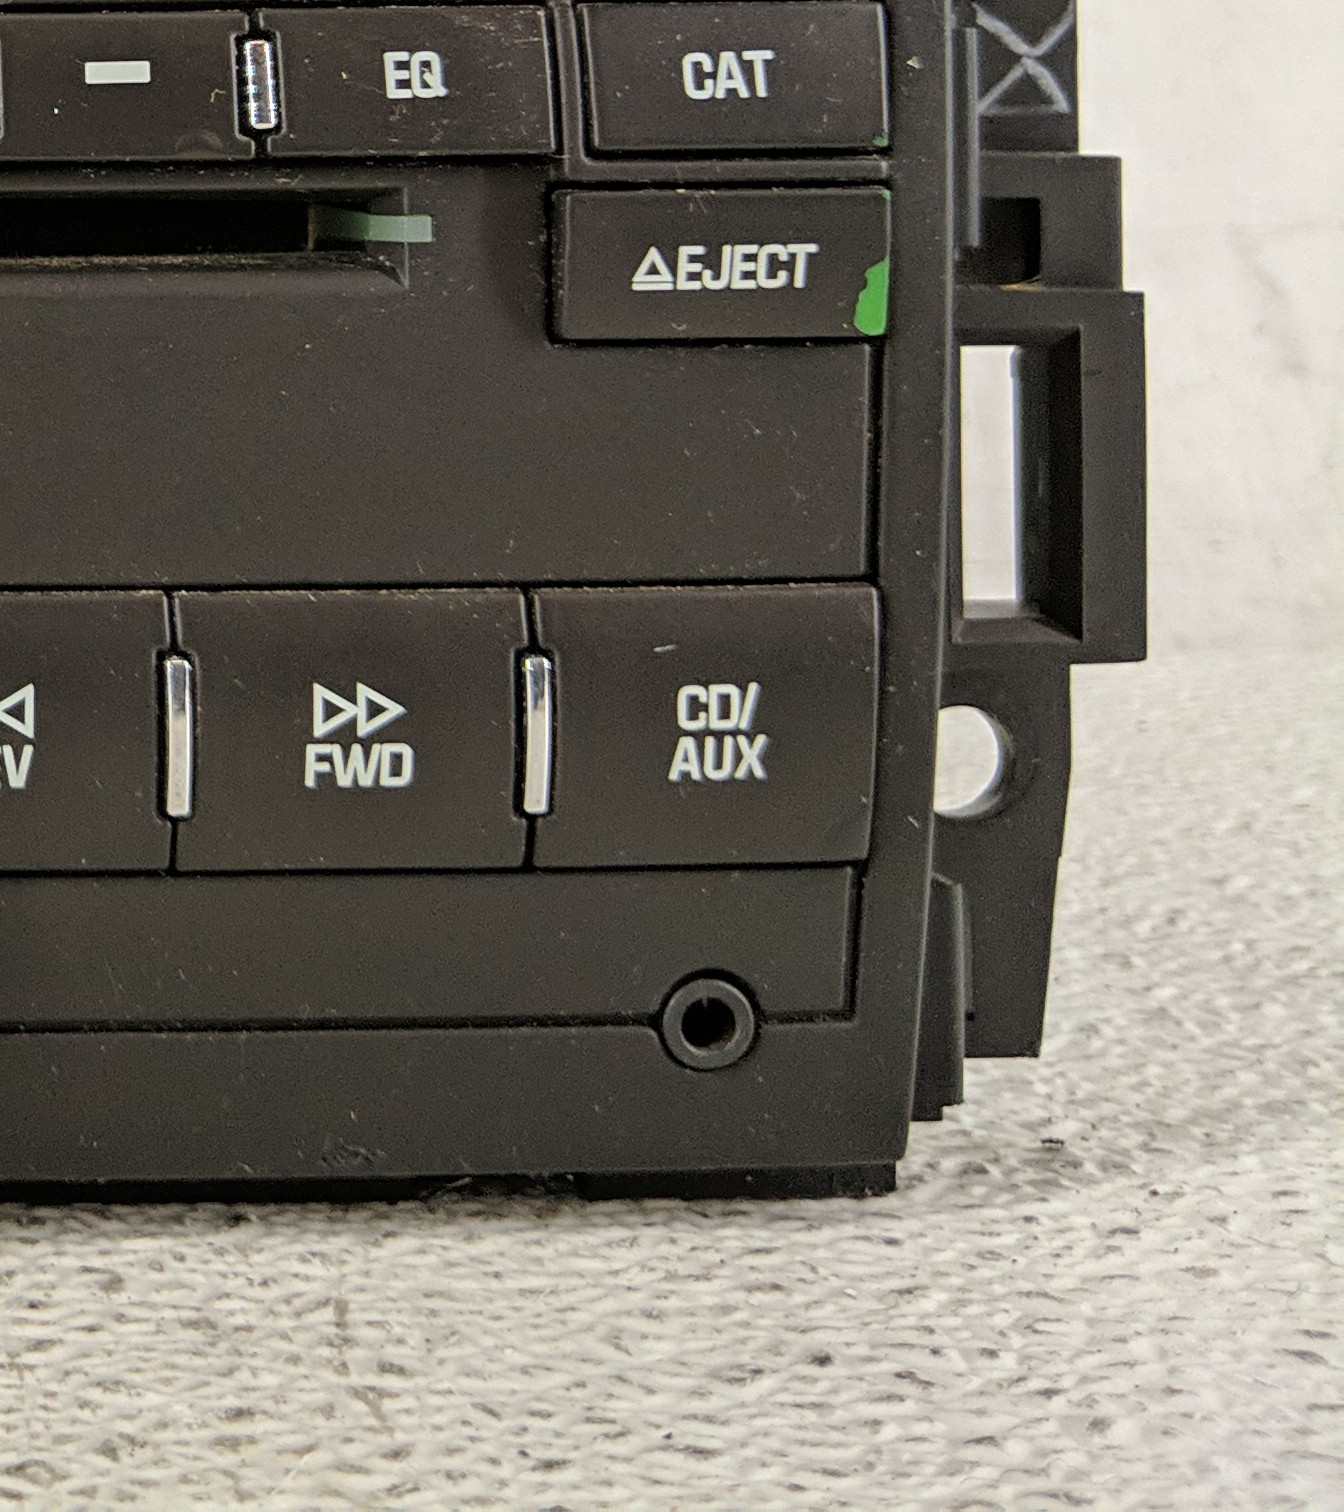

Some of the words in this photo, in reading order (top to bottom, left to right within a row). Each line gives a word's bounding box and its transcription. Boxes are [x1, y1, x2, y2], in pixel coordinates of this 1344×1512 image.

[382, 50, 449, 100] EQ
[681, 49, 776, 100] CAT
[675, 242, 820, 291] EJECT
[676, 681, 760, 732] CD/
[304, 742, 415, 789] FWD
[667, 734, 768, 782] AUX
